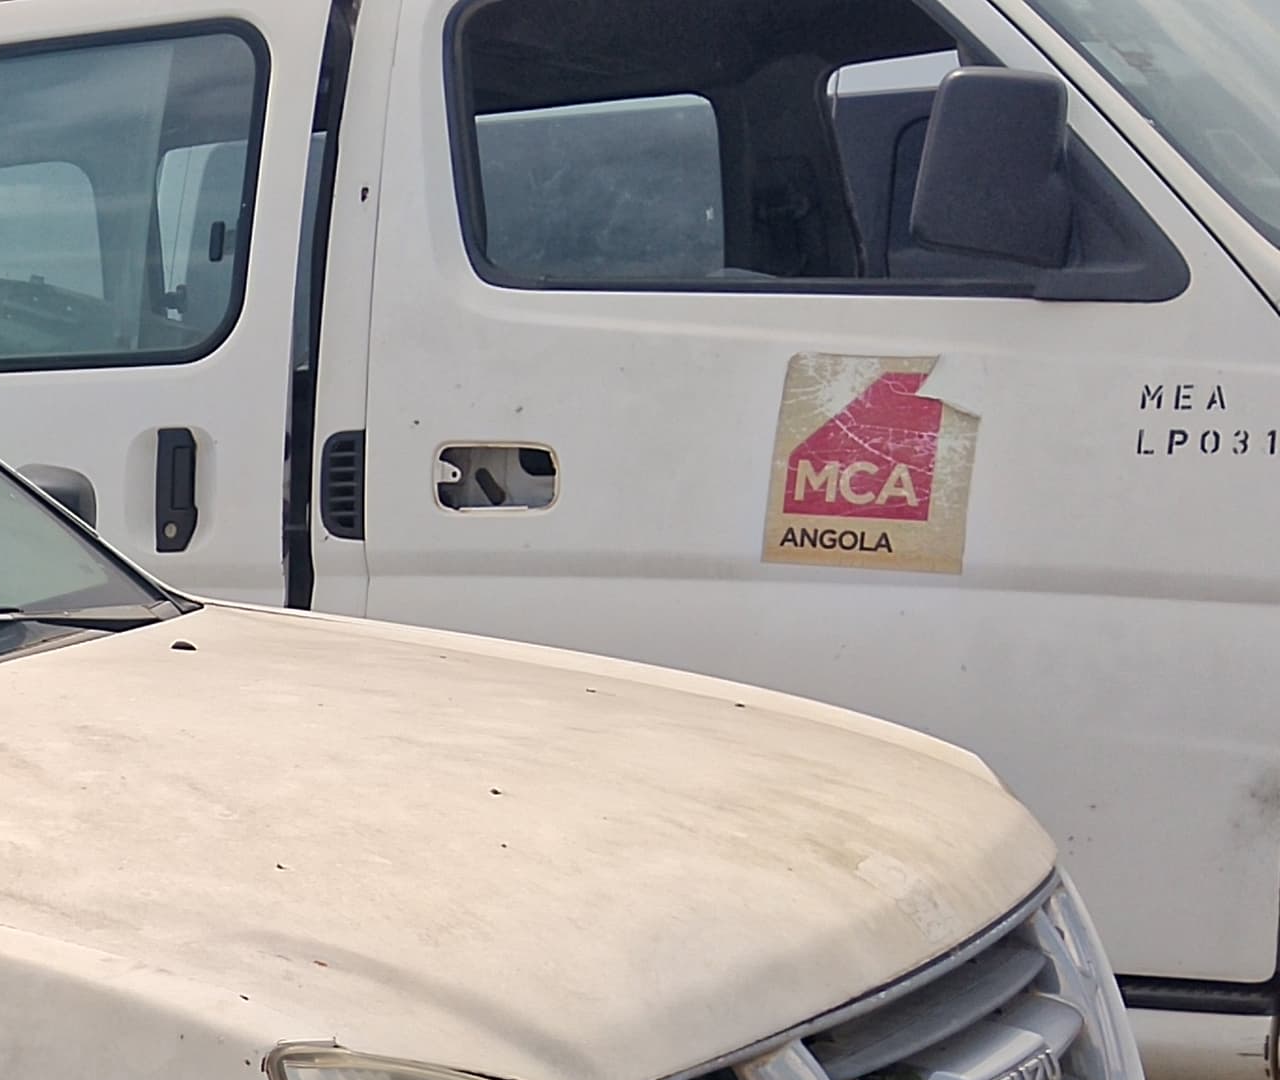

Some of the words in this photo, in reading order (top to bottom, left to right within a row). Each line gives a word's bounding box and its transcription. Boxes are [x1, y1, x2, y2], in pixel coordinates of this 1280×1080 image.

[1140, 384, 1226, 410] MEA
[793, 459, 920, 508] MCA
[778, 526, 894, 554] ANGOLA
